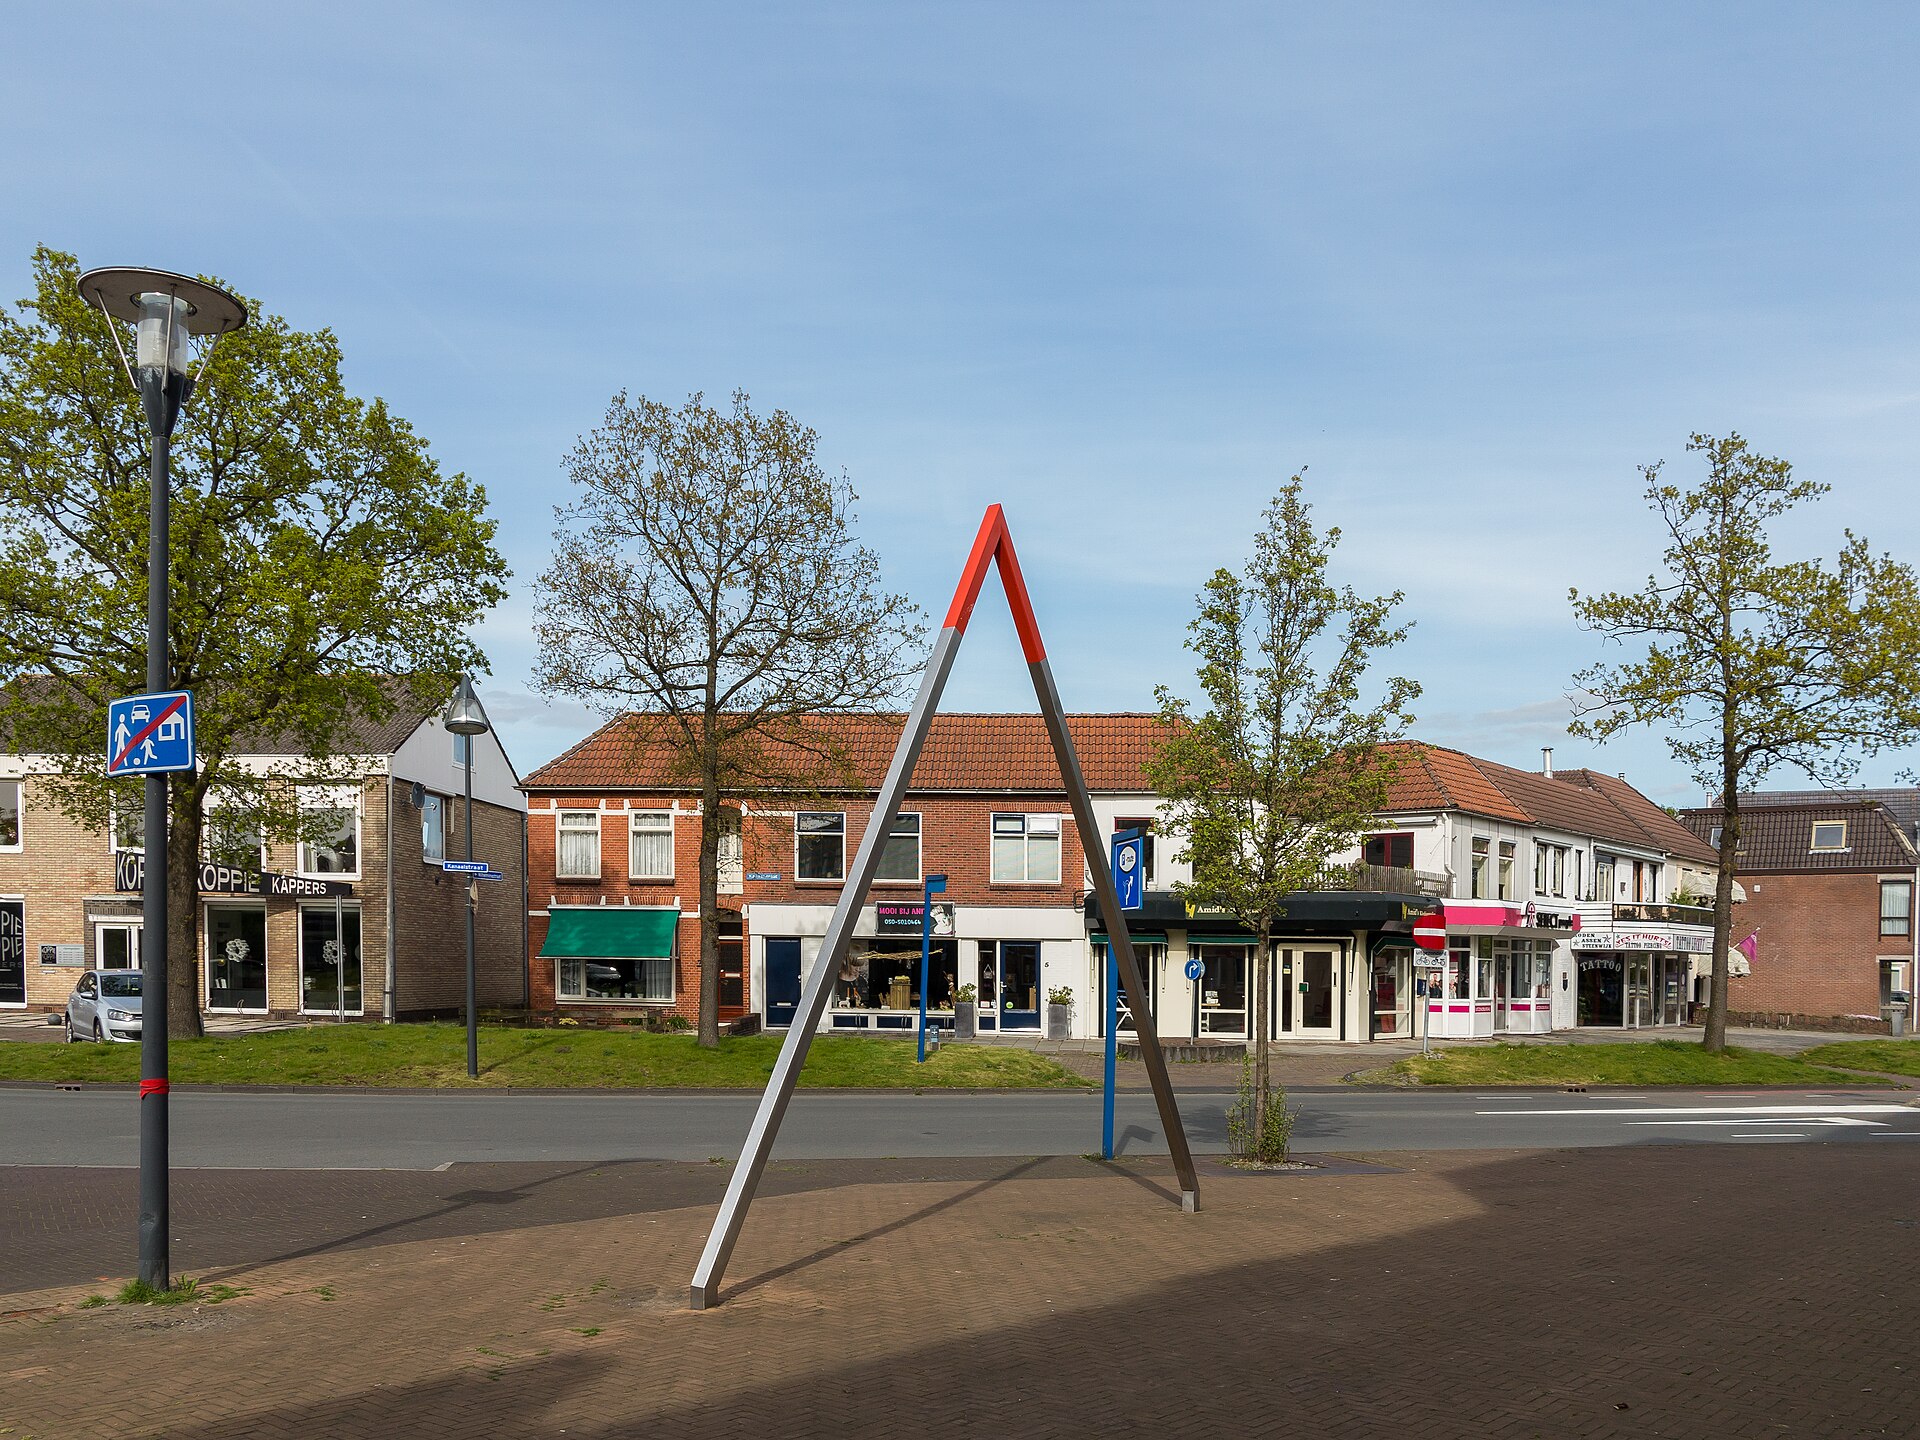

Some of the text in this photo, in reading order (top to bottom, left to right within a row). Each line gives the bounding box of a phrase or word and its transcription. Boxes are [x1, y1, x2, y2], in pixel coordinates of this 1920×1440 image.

[271, 876, 327, 895] KAPPERS
[879, 907, 898, 915] MOOI
[899, 907, 910, 915] BIJ
[1197, 905, 1226, 914] Amid's
[1616, 935, 1631, 945] YES
[1580, 959, 1622, 973] TATTOO
